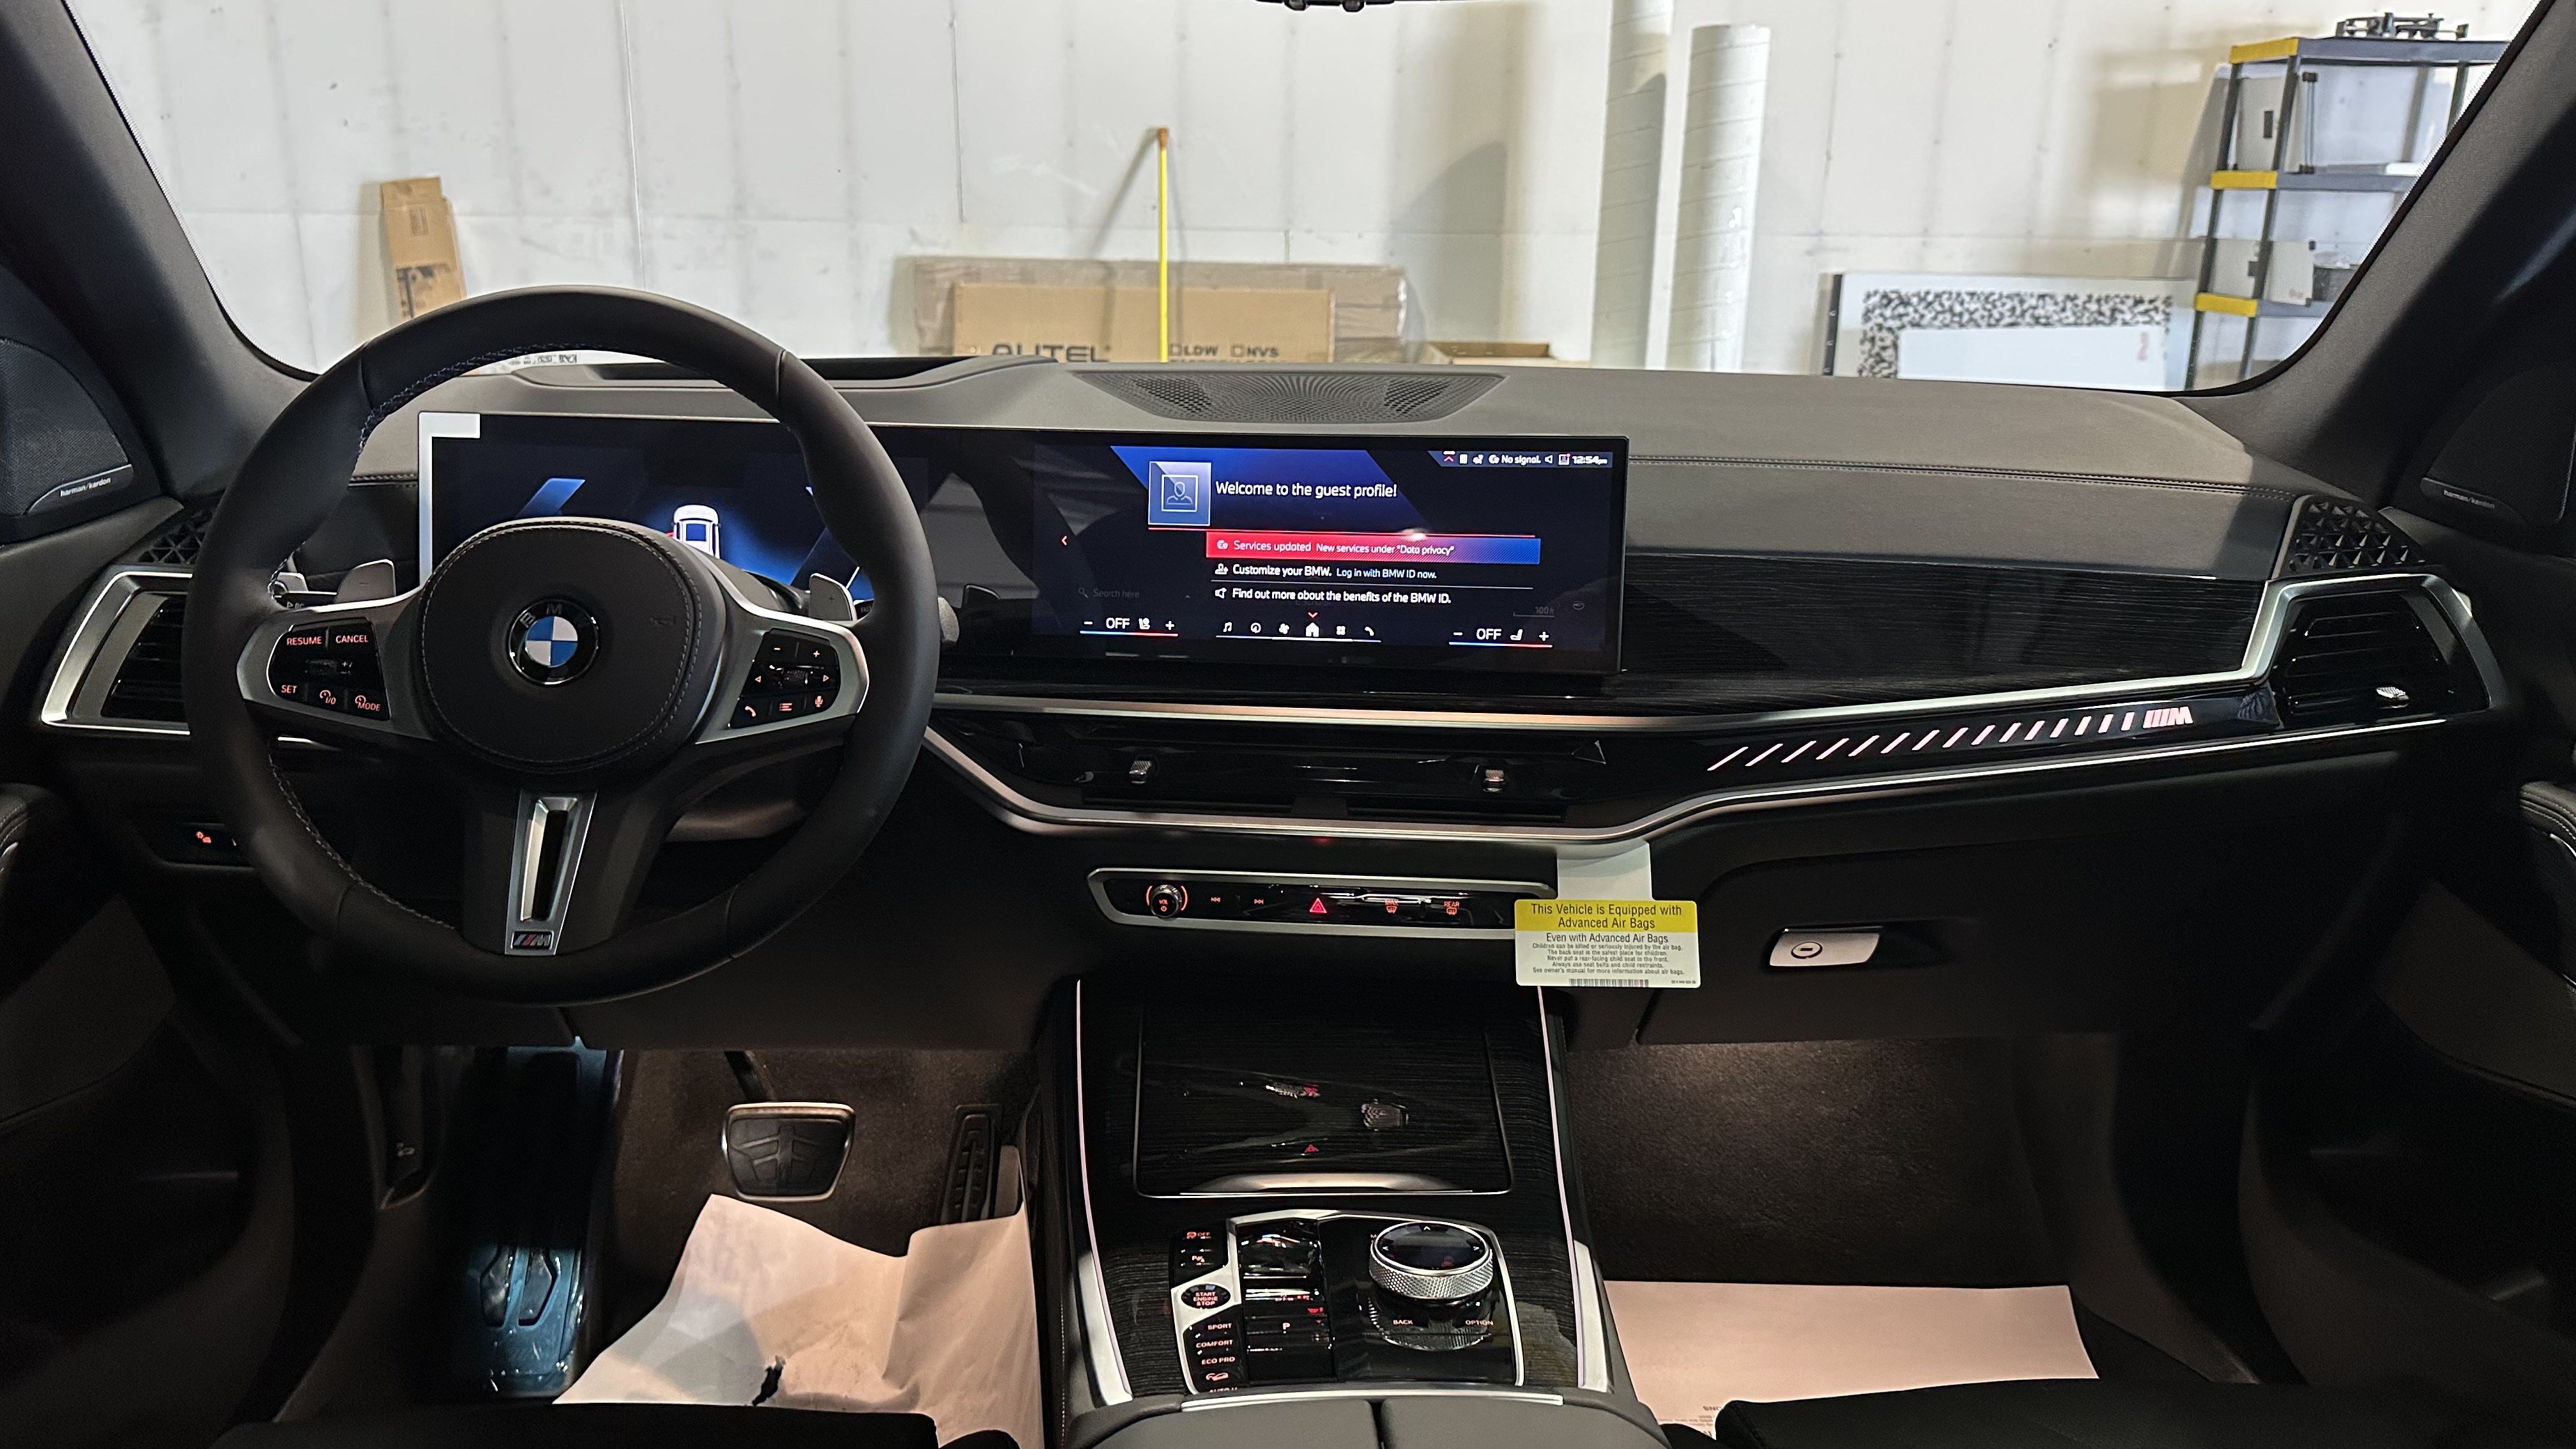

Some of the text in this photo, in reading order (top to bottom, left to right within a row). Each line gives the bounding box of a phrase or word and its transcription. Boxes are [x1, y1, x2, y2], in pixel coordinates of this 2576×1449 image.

[1184, 346, 1218, 356] LDW
[1501, 455, 1513, 464] No
[61, 478, 111, 497] harman/kardon
[1216, 481, 1397, 499] Welcome to the guest profile!
[1234, 540, 1311, 553] Services updated
[1316, 543, 1454, 556] New services under "Data privacy"
[1233, 564, 1332, 577] Customize your BMW.
[1337, 568, 1352, 578] Log
[1363, 569, 1380, 577] with
[1383, 569, 1405, 578] BMW
[1417, 571, 1437, 579] now.
[1093, 588, 1119, 598] Search
[1232, 588, 1451, 603] Find out more about the benefits of the BMW ID.
[1106, 617, 1130, 629] OFF
[335, 635, 369, 643] CANCEL
[1476, 628, 1501, 640] OFF
[287, 636, 322, 645] RESUME
[281, 685, 297, 693] SET
[358, 703, 381, 711] MODE
[1531, 903, 1682, 917] This Vehicle is Equipped with
[1558, 917, 1655, 930] Advanced Air Bags
[1547, 933, 1668, 944] Even with Advanced Air Bags
[1196, 1340, 1233, 1348] COMFORT
